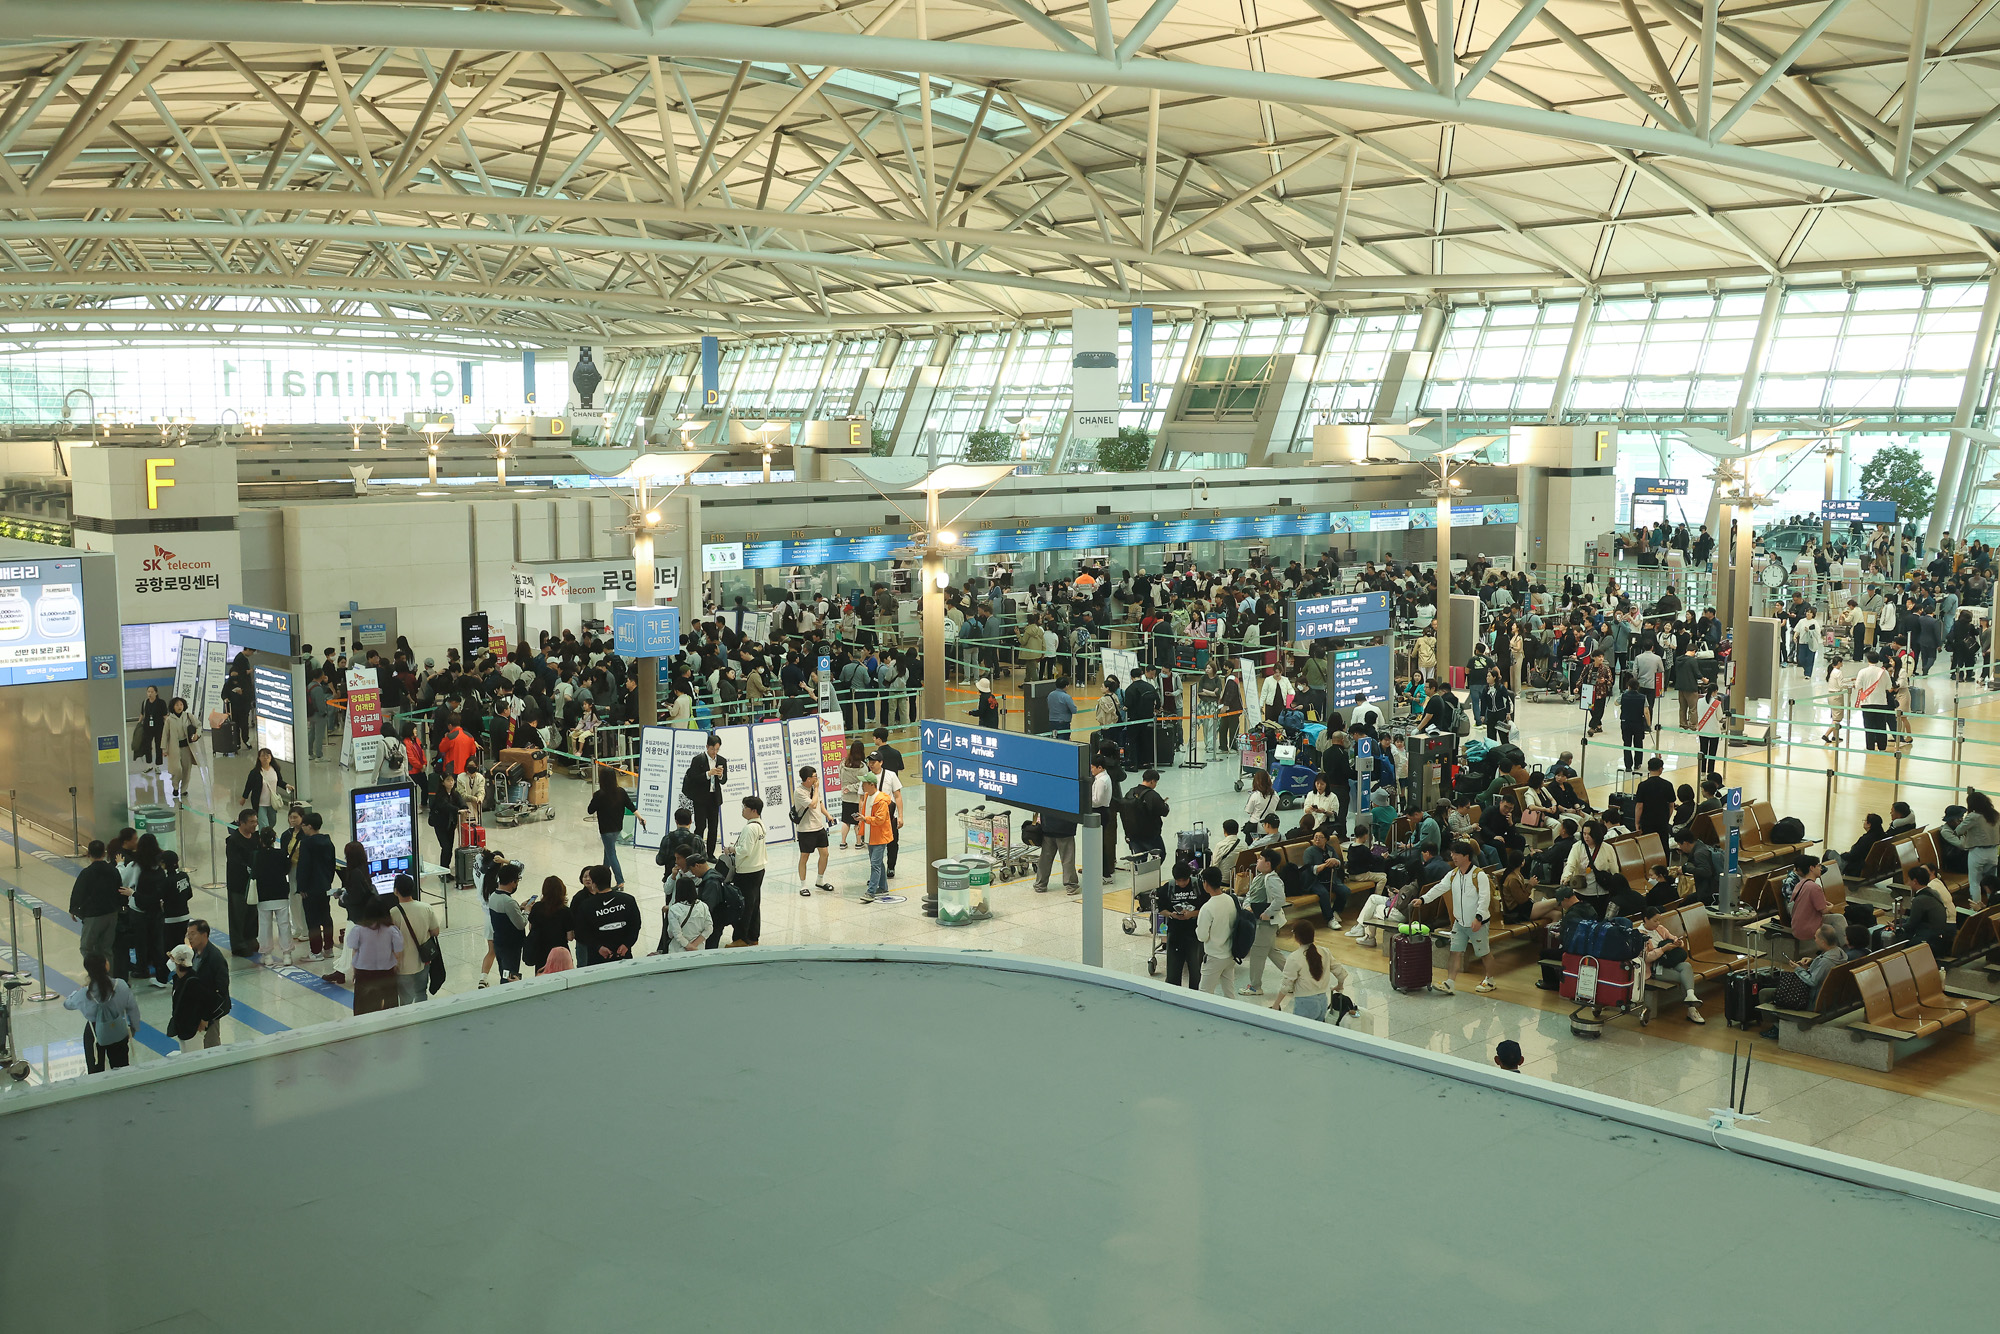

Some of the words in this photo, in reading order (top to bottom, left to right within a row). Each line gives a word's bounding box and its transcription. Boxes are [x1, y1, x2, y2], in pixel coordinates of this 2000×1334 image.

[526, 392, 535, 403] C
[707, 390, 718, 404] D
[1141, 383, 1150, 401] E
[463, 394, 470, 403] B
[1079, 416, 1114, 424] CHANEL
[551, 419, 565, 435] D
[850, 424, 861, 445] E
[1595, 431, 1609, 461] F
[146, 458, 175, 510] F
[746, 532, 760, 540] F17
[869, 526, 882, 534] F15
[710, 534, 725, 542] F18
[143, 559, 162, 571] SK
[168, 560, 211, 570] telecom
[135, 574, 220, 593] 공항로밍센터
[541, 585, 557, 596] SK
[561, 587, 596, 596] telecom
[601, 566, 678, 591] 로밍터
[1380, 595, 1386, 607] 3
[647, 619, 671, 634] 카트
[647, 636, 671, 645] CARTS
[351, 693, 377, 703] 당일출국
[355, 703, 375, 712] 여객만
[353, 713, 380, 723] 유심교체
[361, 724, 375, 732] 가능
[793, 736, 817, 746] 이용안내
[822, 740, 843, 750] 일출국
[955, 736, 968, 749] 도착
[645, 746, 670, 756] 이용안내
[971, 746, 995, 758] Arrivals
[727, 763, 748, 773] 밍센터
[956, 768, 976, 782] 주차장
[978, 780, 1003, 795] Parking
[595, 904, 626, 917] NOCTA
